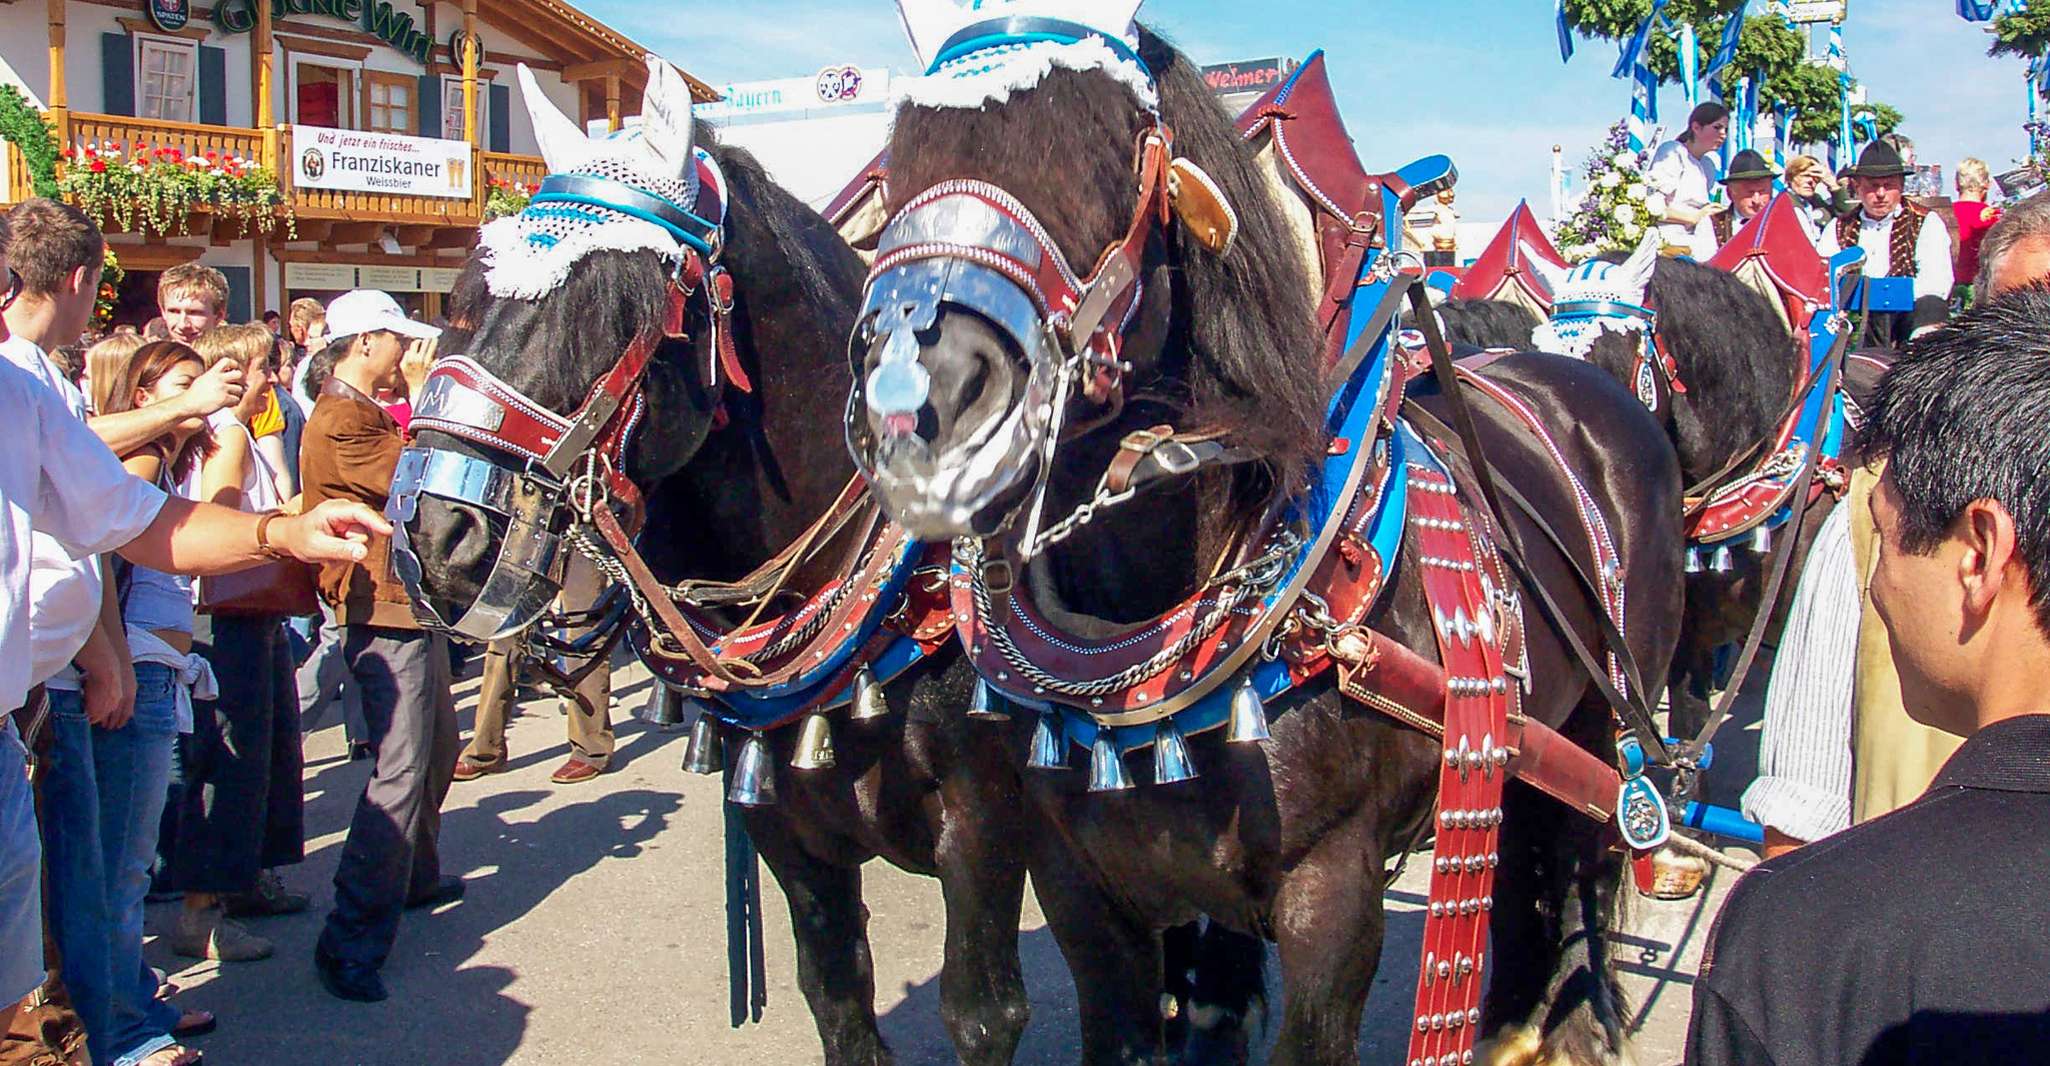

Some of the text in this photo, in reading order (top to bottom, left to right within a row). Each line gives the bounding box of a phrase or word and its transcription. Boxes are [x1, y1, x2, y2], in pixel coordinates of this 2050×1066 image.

[318, 132, 336, 145] Und
[338, 134, 361, 149] jetzt
[363, 137, 377, 149] ein
[332, 151, 441, 178] Franziskaner
[366, 176, 411, 189] Weissbier
